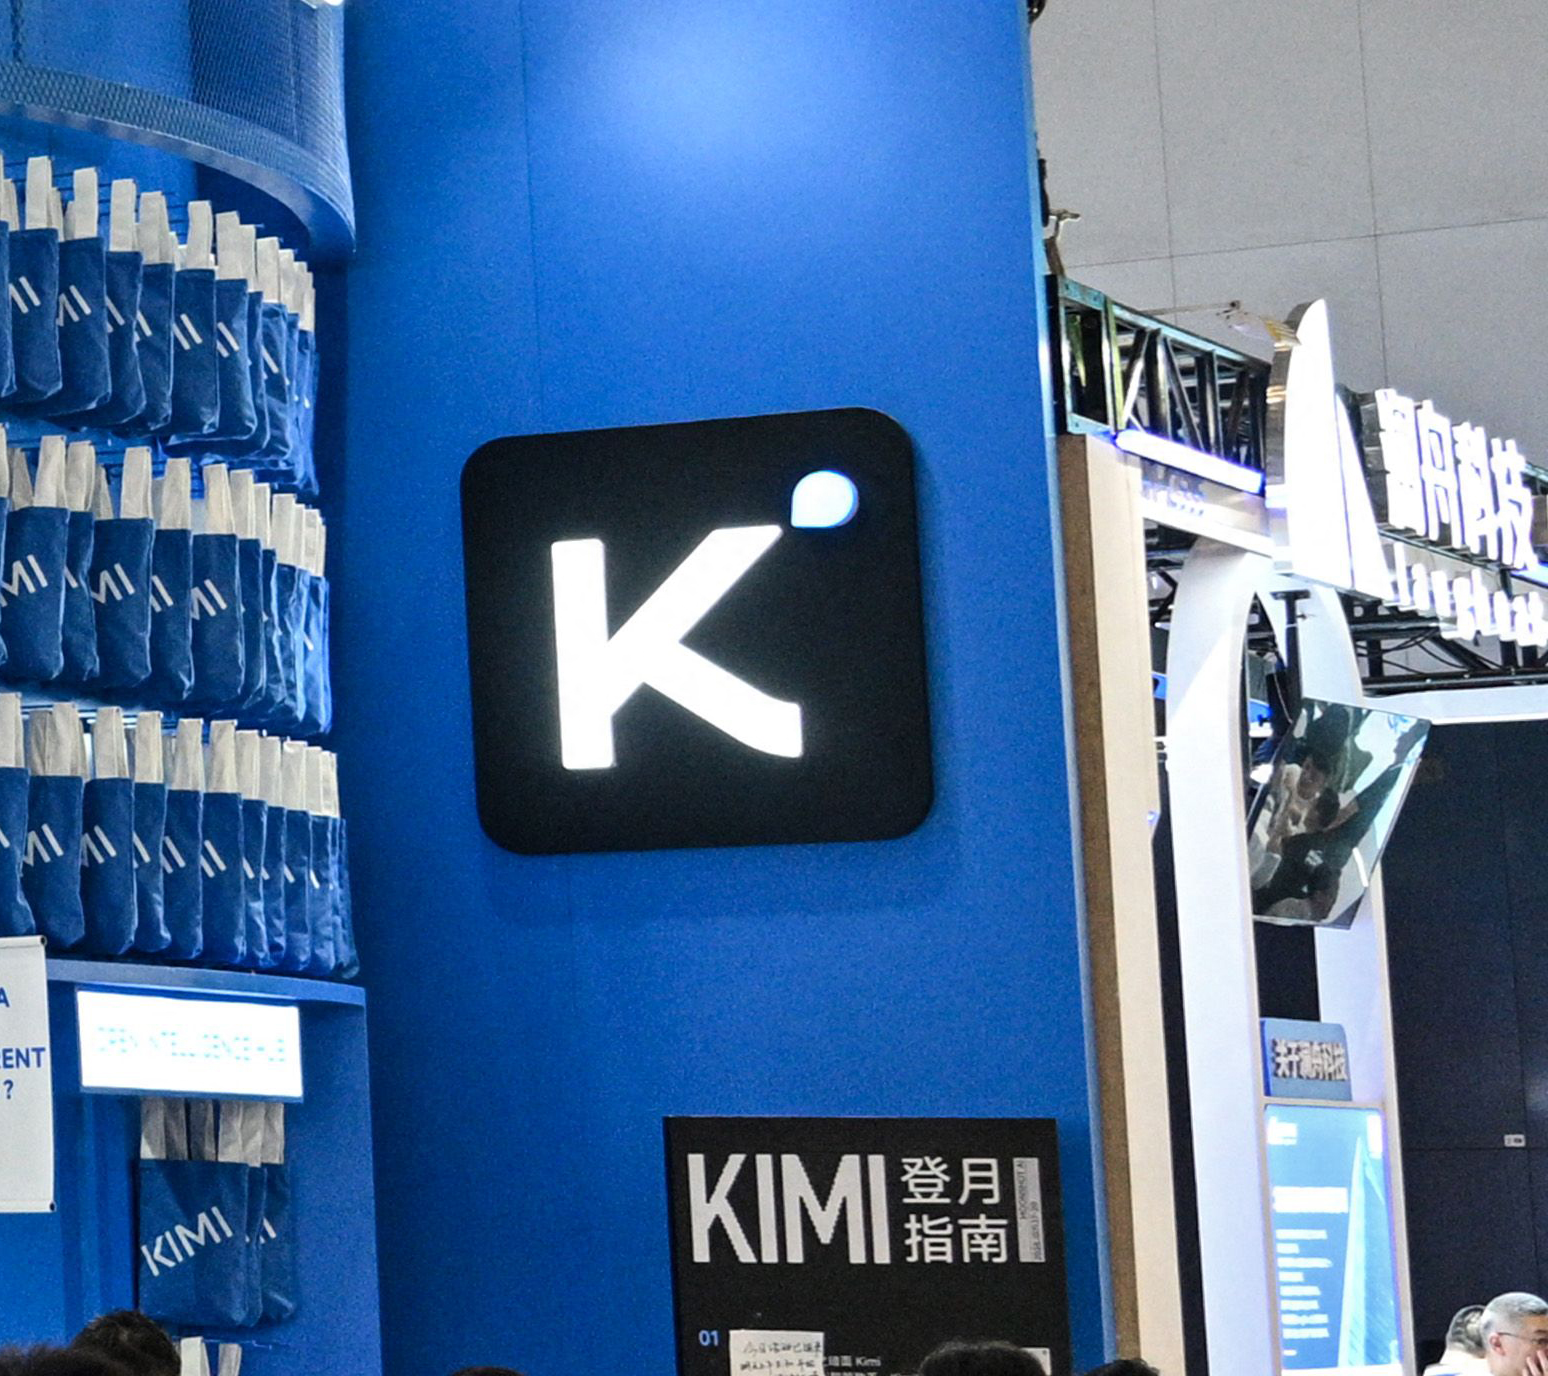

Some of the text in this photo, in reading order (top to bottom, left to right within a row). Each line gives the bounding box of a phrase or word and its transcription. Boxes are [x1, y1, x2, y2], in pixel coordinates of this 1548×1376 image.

[900, 1156, 1000, 1206] 登月
[687, 1153, 891, 1264] KIMI
[141, 1206, 232, 1277] KIMI
[904, 1215, 1008, 1264] 指南
[699, 1330, 719, 1346] 01
